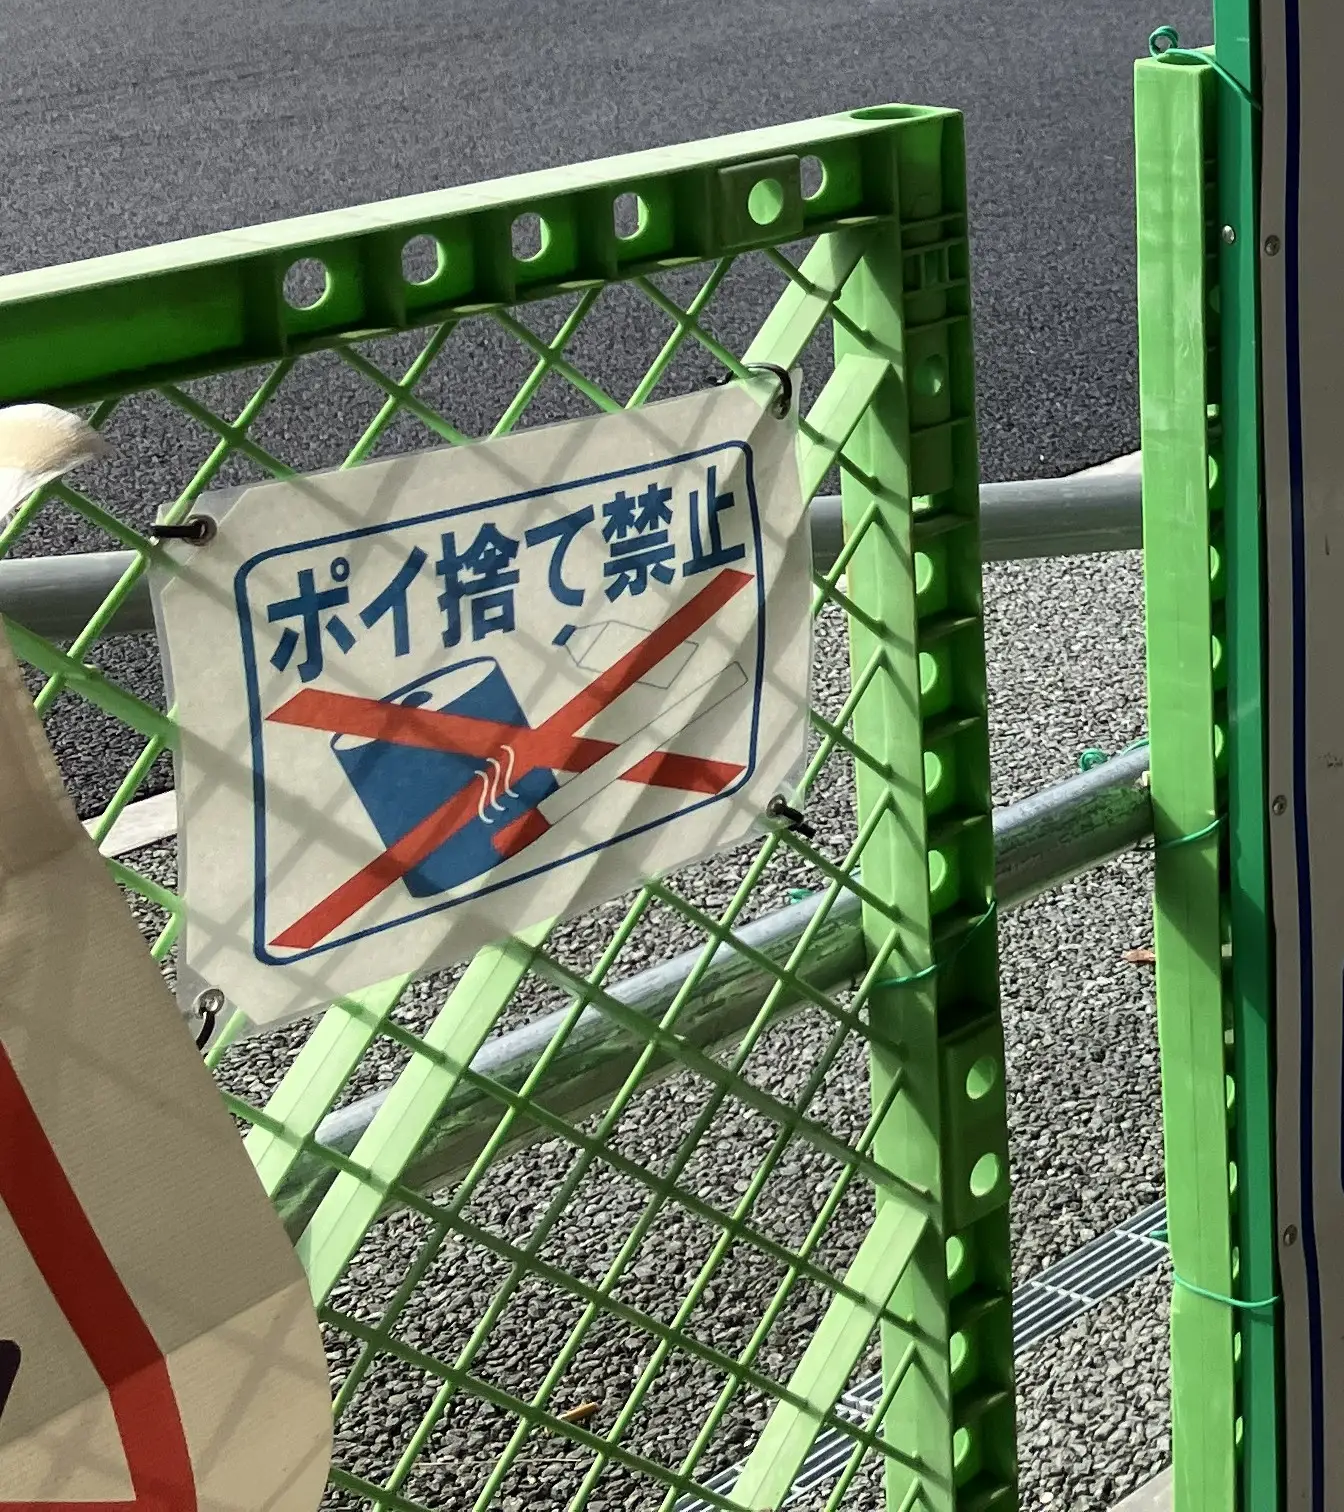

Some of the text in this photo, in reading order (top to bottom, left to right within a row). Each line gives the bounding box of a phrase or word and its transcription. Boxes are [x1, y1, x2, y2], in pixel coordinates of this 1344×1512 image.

[266, 463, 746, 684] ポイ捨て禁止
